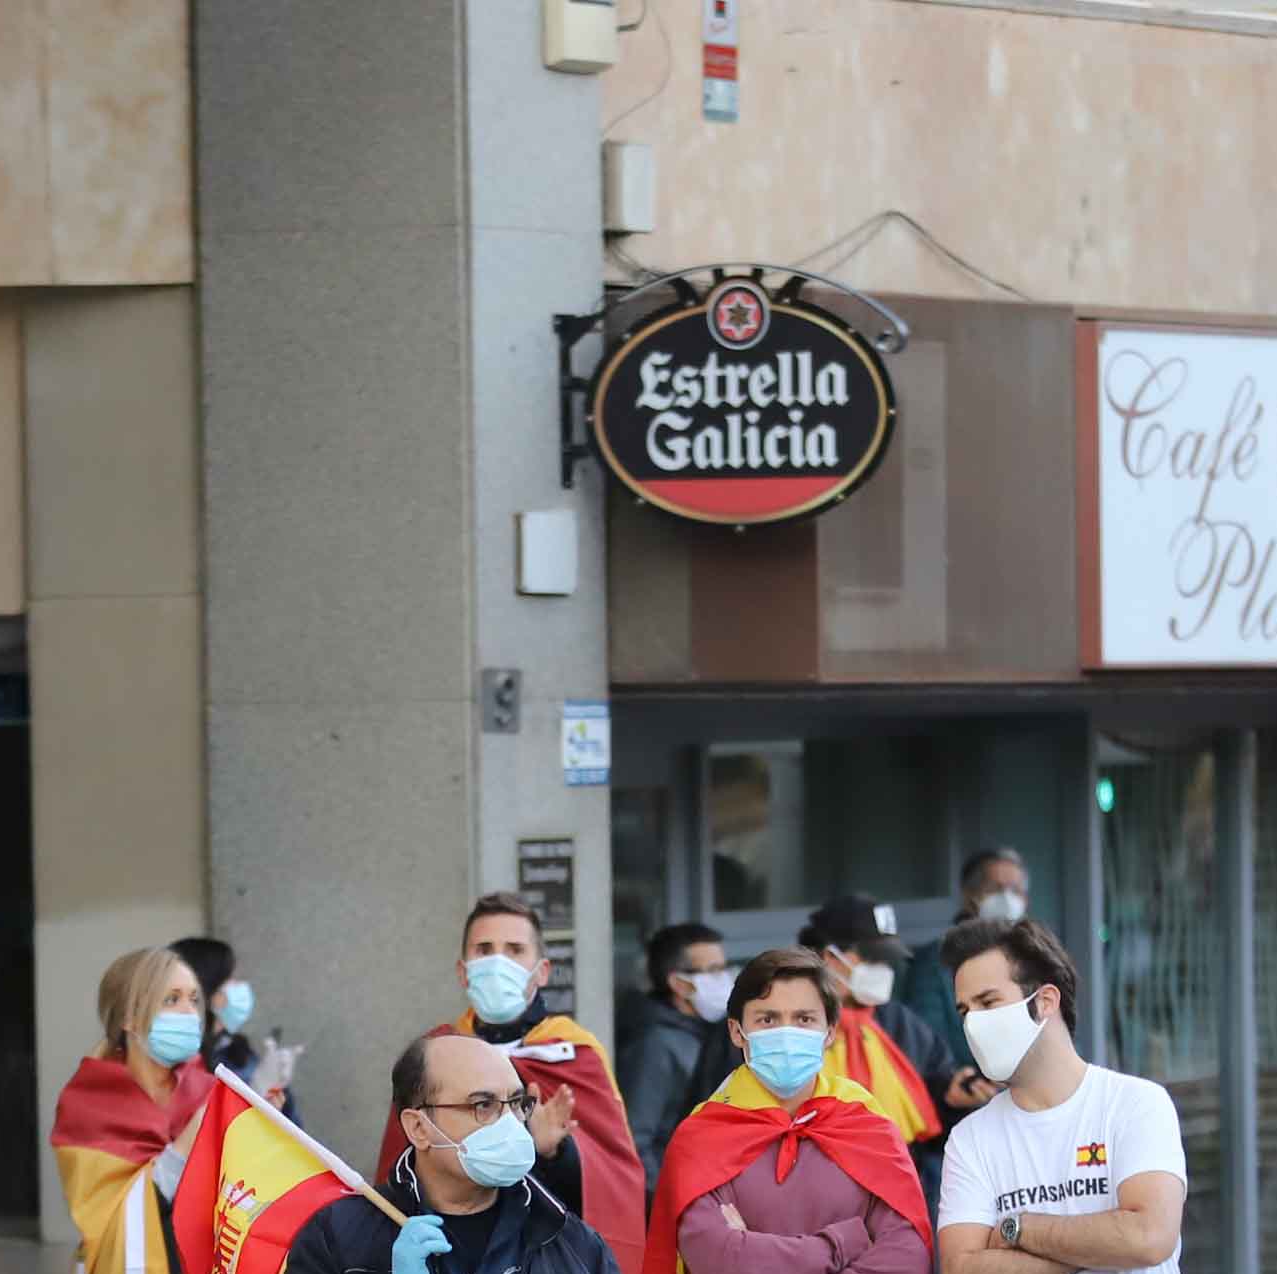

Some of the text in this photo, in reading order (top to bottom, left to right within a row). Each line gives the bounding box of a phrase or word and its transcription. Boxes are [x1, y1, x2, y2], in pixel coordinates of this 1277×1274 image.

[635, 351, 850, 410] Estrella
[646, 408, 840, 471] Galicia
[1104, 349, 1265, 526] Café
